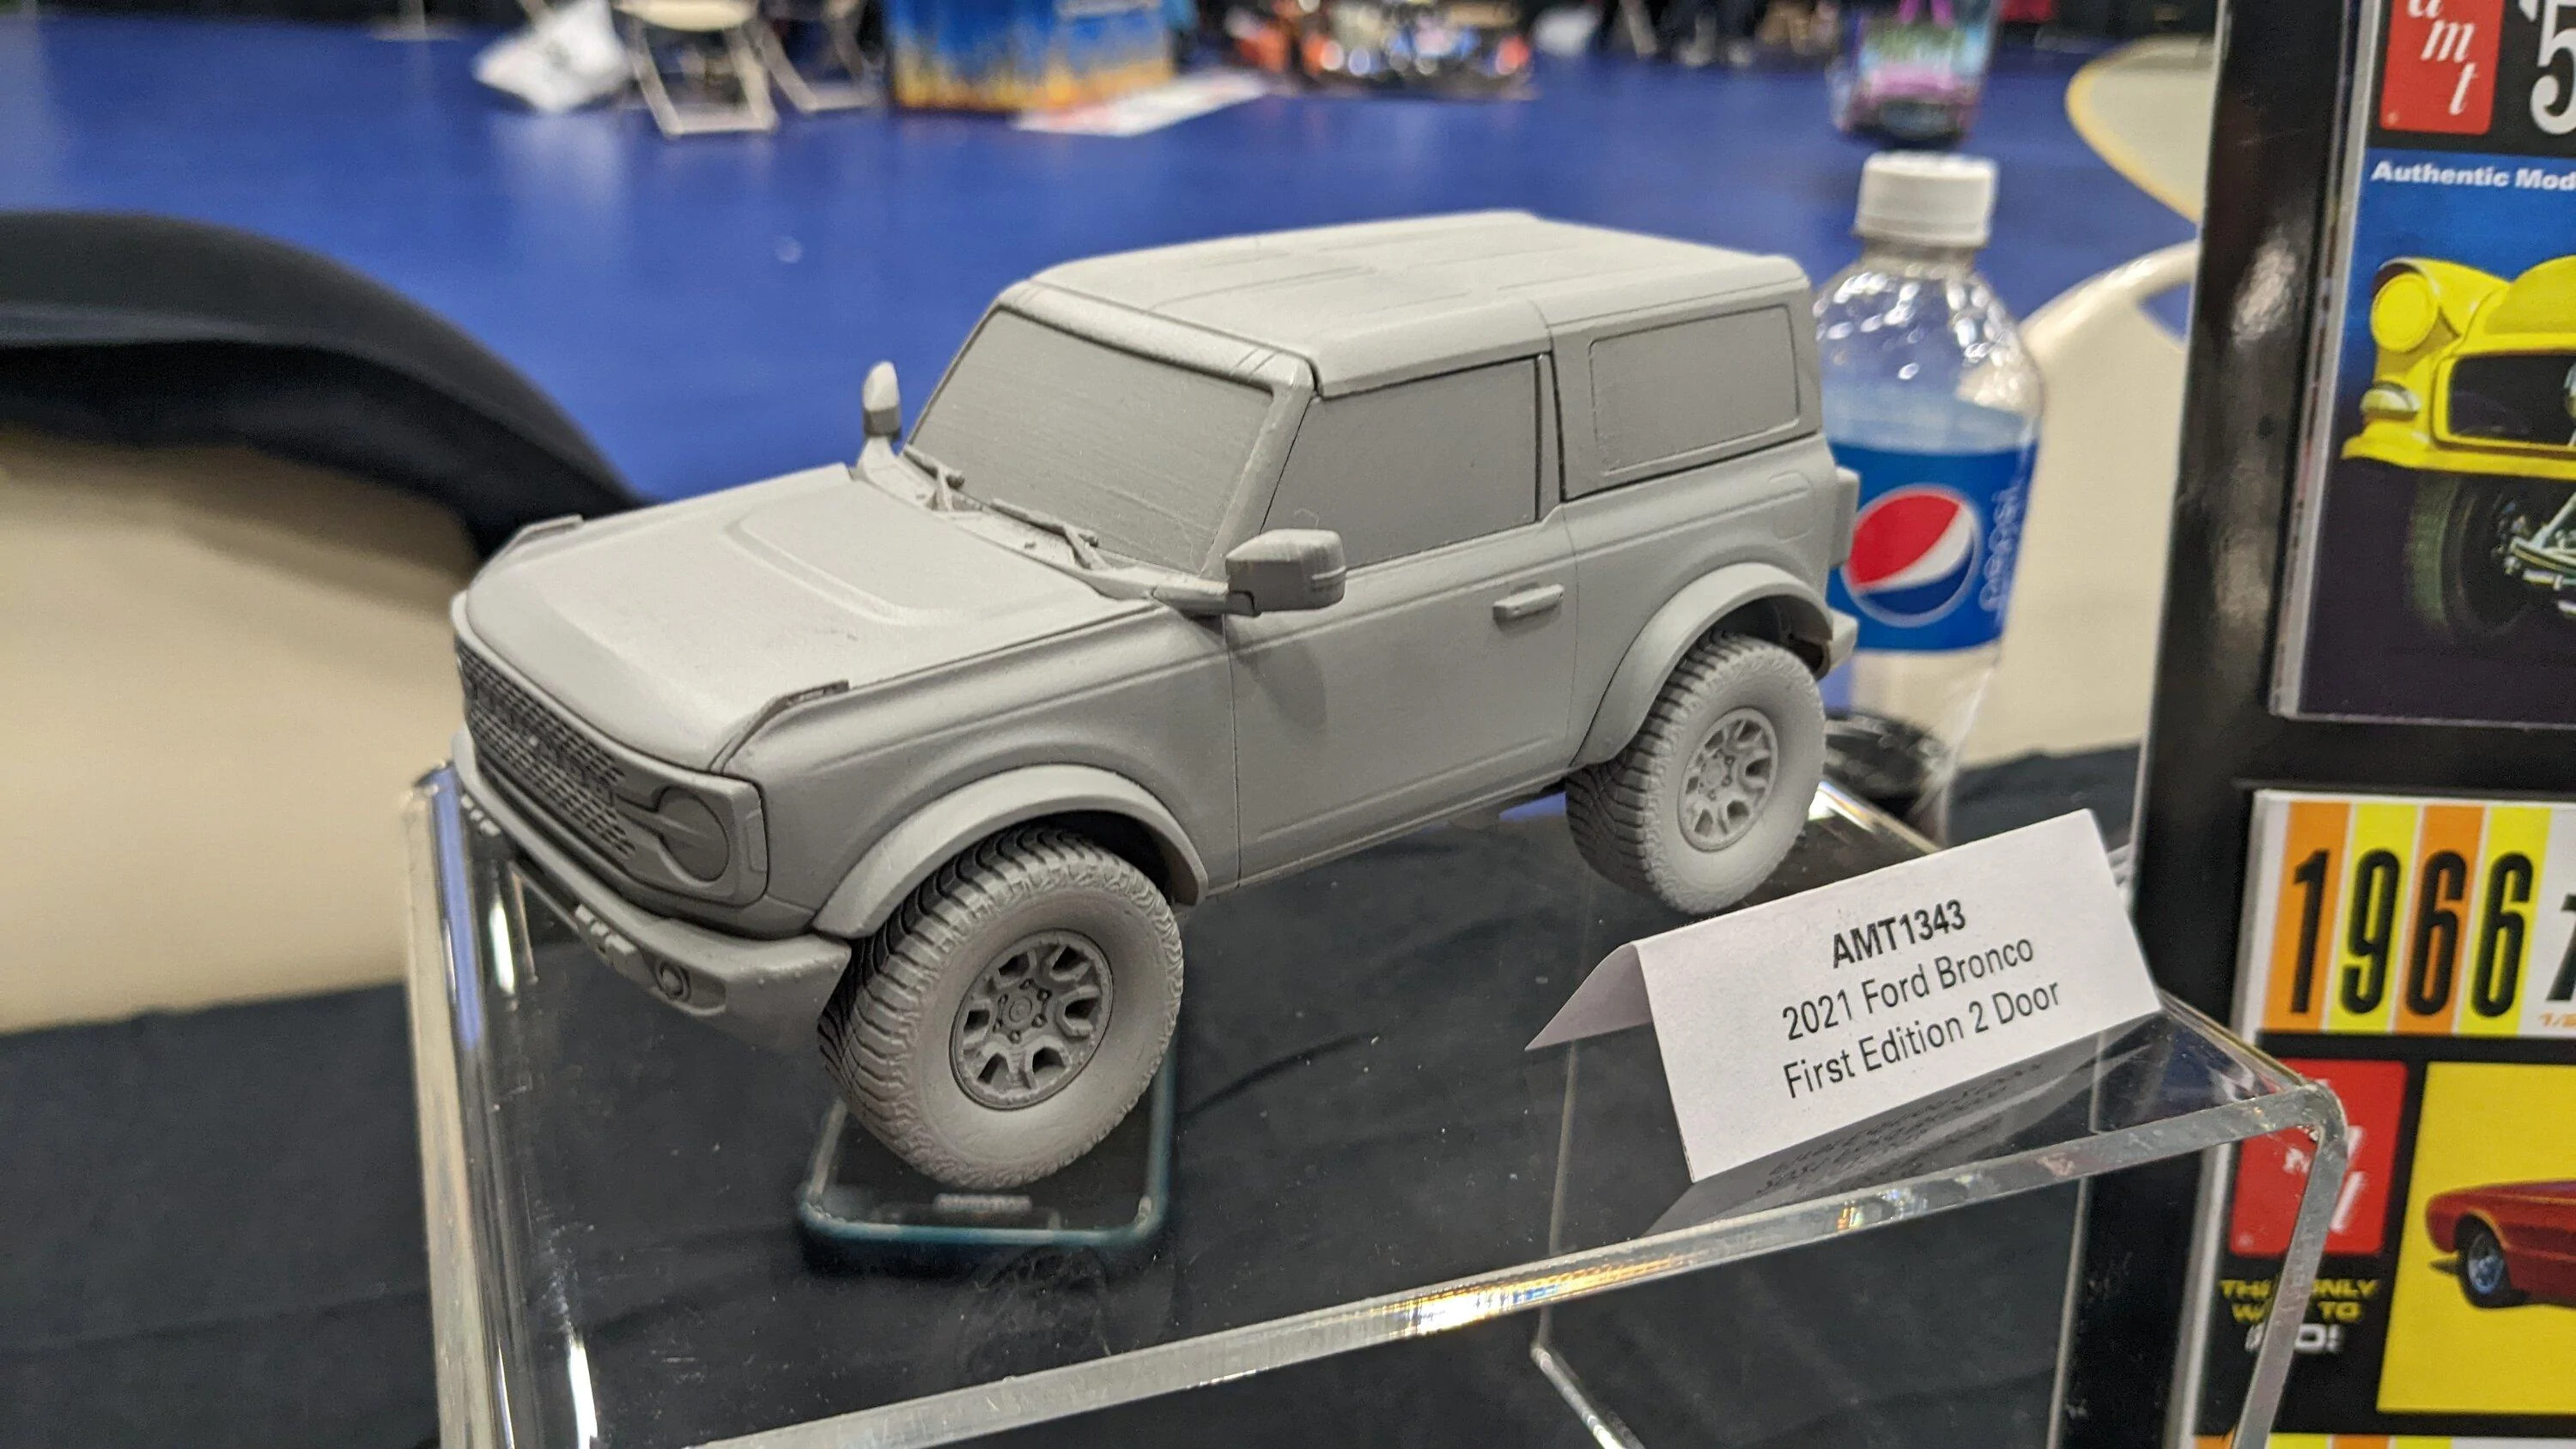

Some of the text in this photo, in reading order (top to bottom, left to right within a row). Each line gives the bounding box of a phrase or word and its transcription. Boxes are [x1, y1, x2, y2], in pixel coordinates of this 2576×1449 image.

[2371, 161, 2576, 191] Authentic Mod
[1832, 899, 1966, 968] AMT1343
[2290, 848, 2533, 1017] 1966
[1783, 938, 2034, 1040] 2021 Ford Bronco
[1783, 982, 2059, 1099] First Edition 2 Door
[2318, 1301, 2361, 1322] TO
